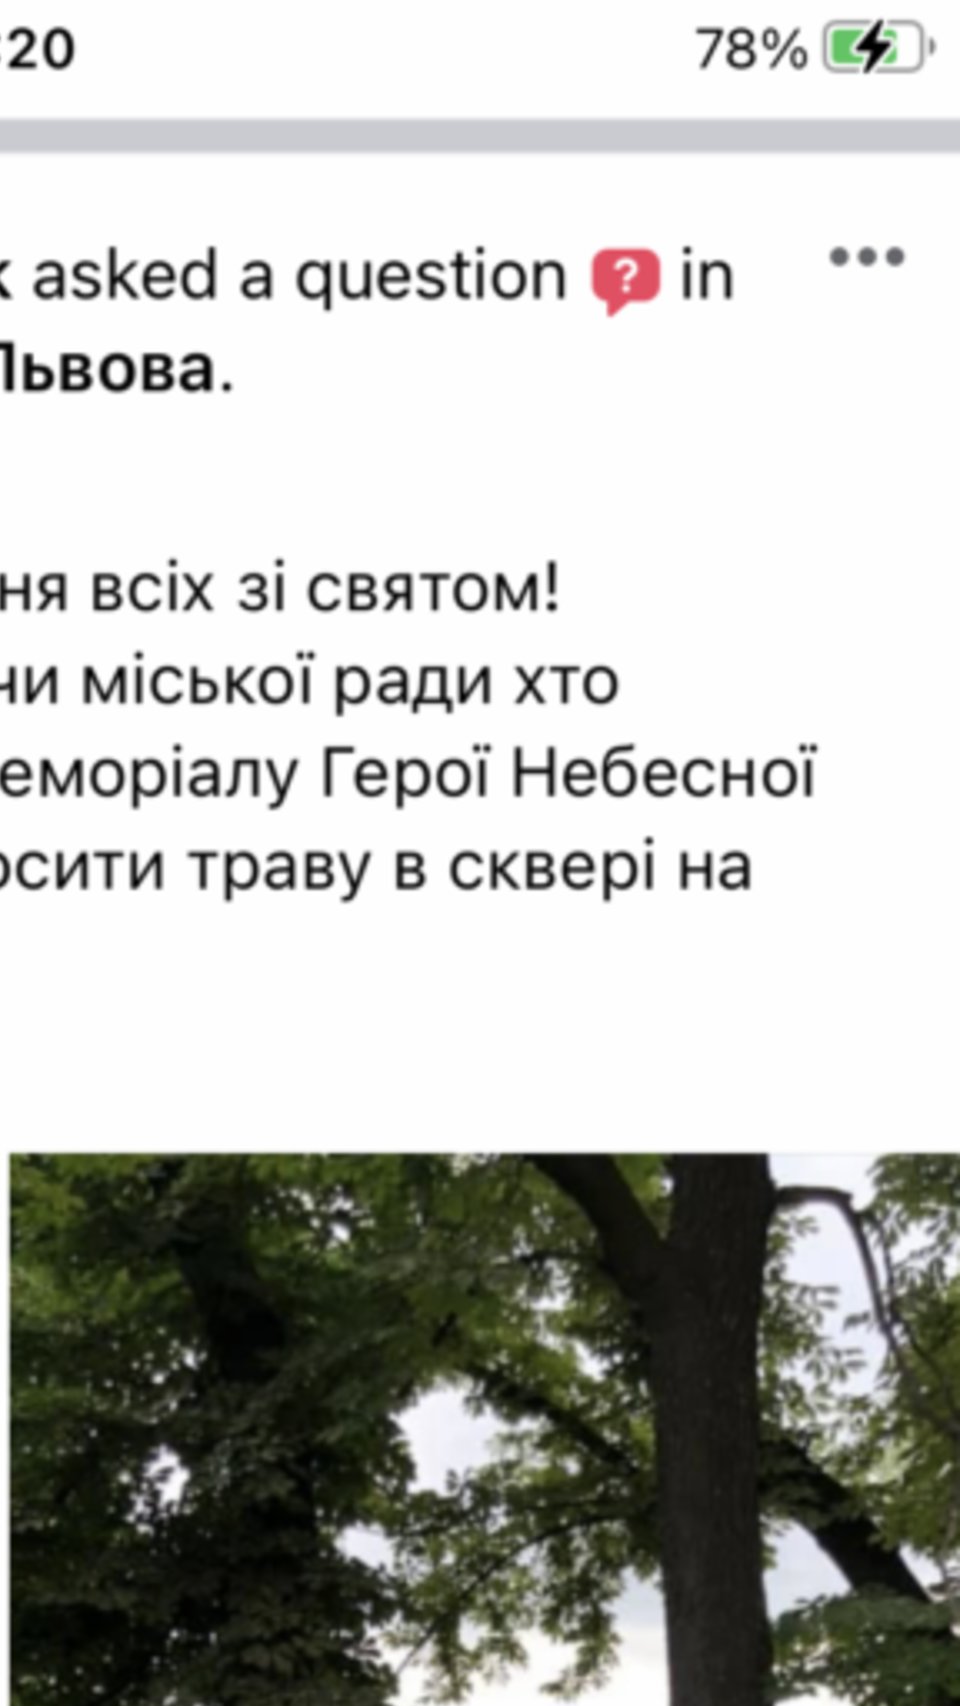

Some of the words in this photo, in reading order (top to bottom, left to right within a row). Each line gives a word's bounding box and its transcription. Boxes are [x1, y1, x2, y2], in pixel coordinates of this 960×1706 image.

[696, 27, 808, 70] 78%
[33, 246, 216, 300] asked
[240, 260, 273, 300] a
[296, 246, 565, 311] question
[683, 246, 733, 300] in
[93, 558, 213, 612] всіх
[239, 558, 284, 612] зі
[307, 560, 557, 612] святом!
[83, 651, 315, 705] міської
[336, 665, 491, 717] ради
[515, 665, 619, 705] хто
[323, 743, 492, 810] Герої
[514, 743, 818, 798] Небесної
[187, 850, 371, 903] траву
[396, 851, 426, 890] в
[450, 836, 654, 902] сквері
[680, 850, 751, 891] на
